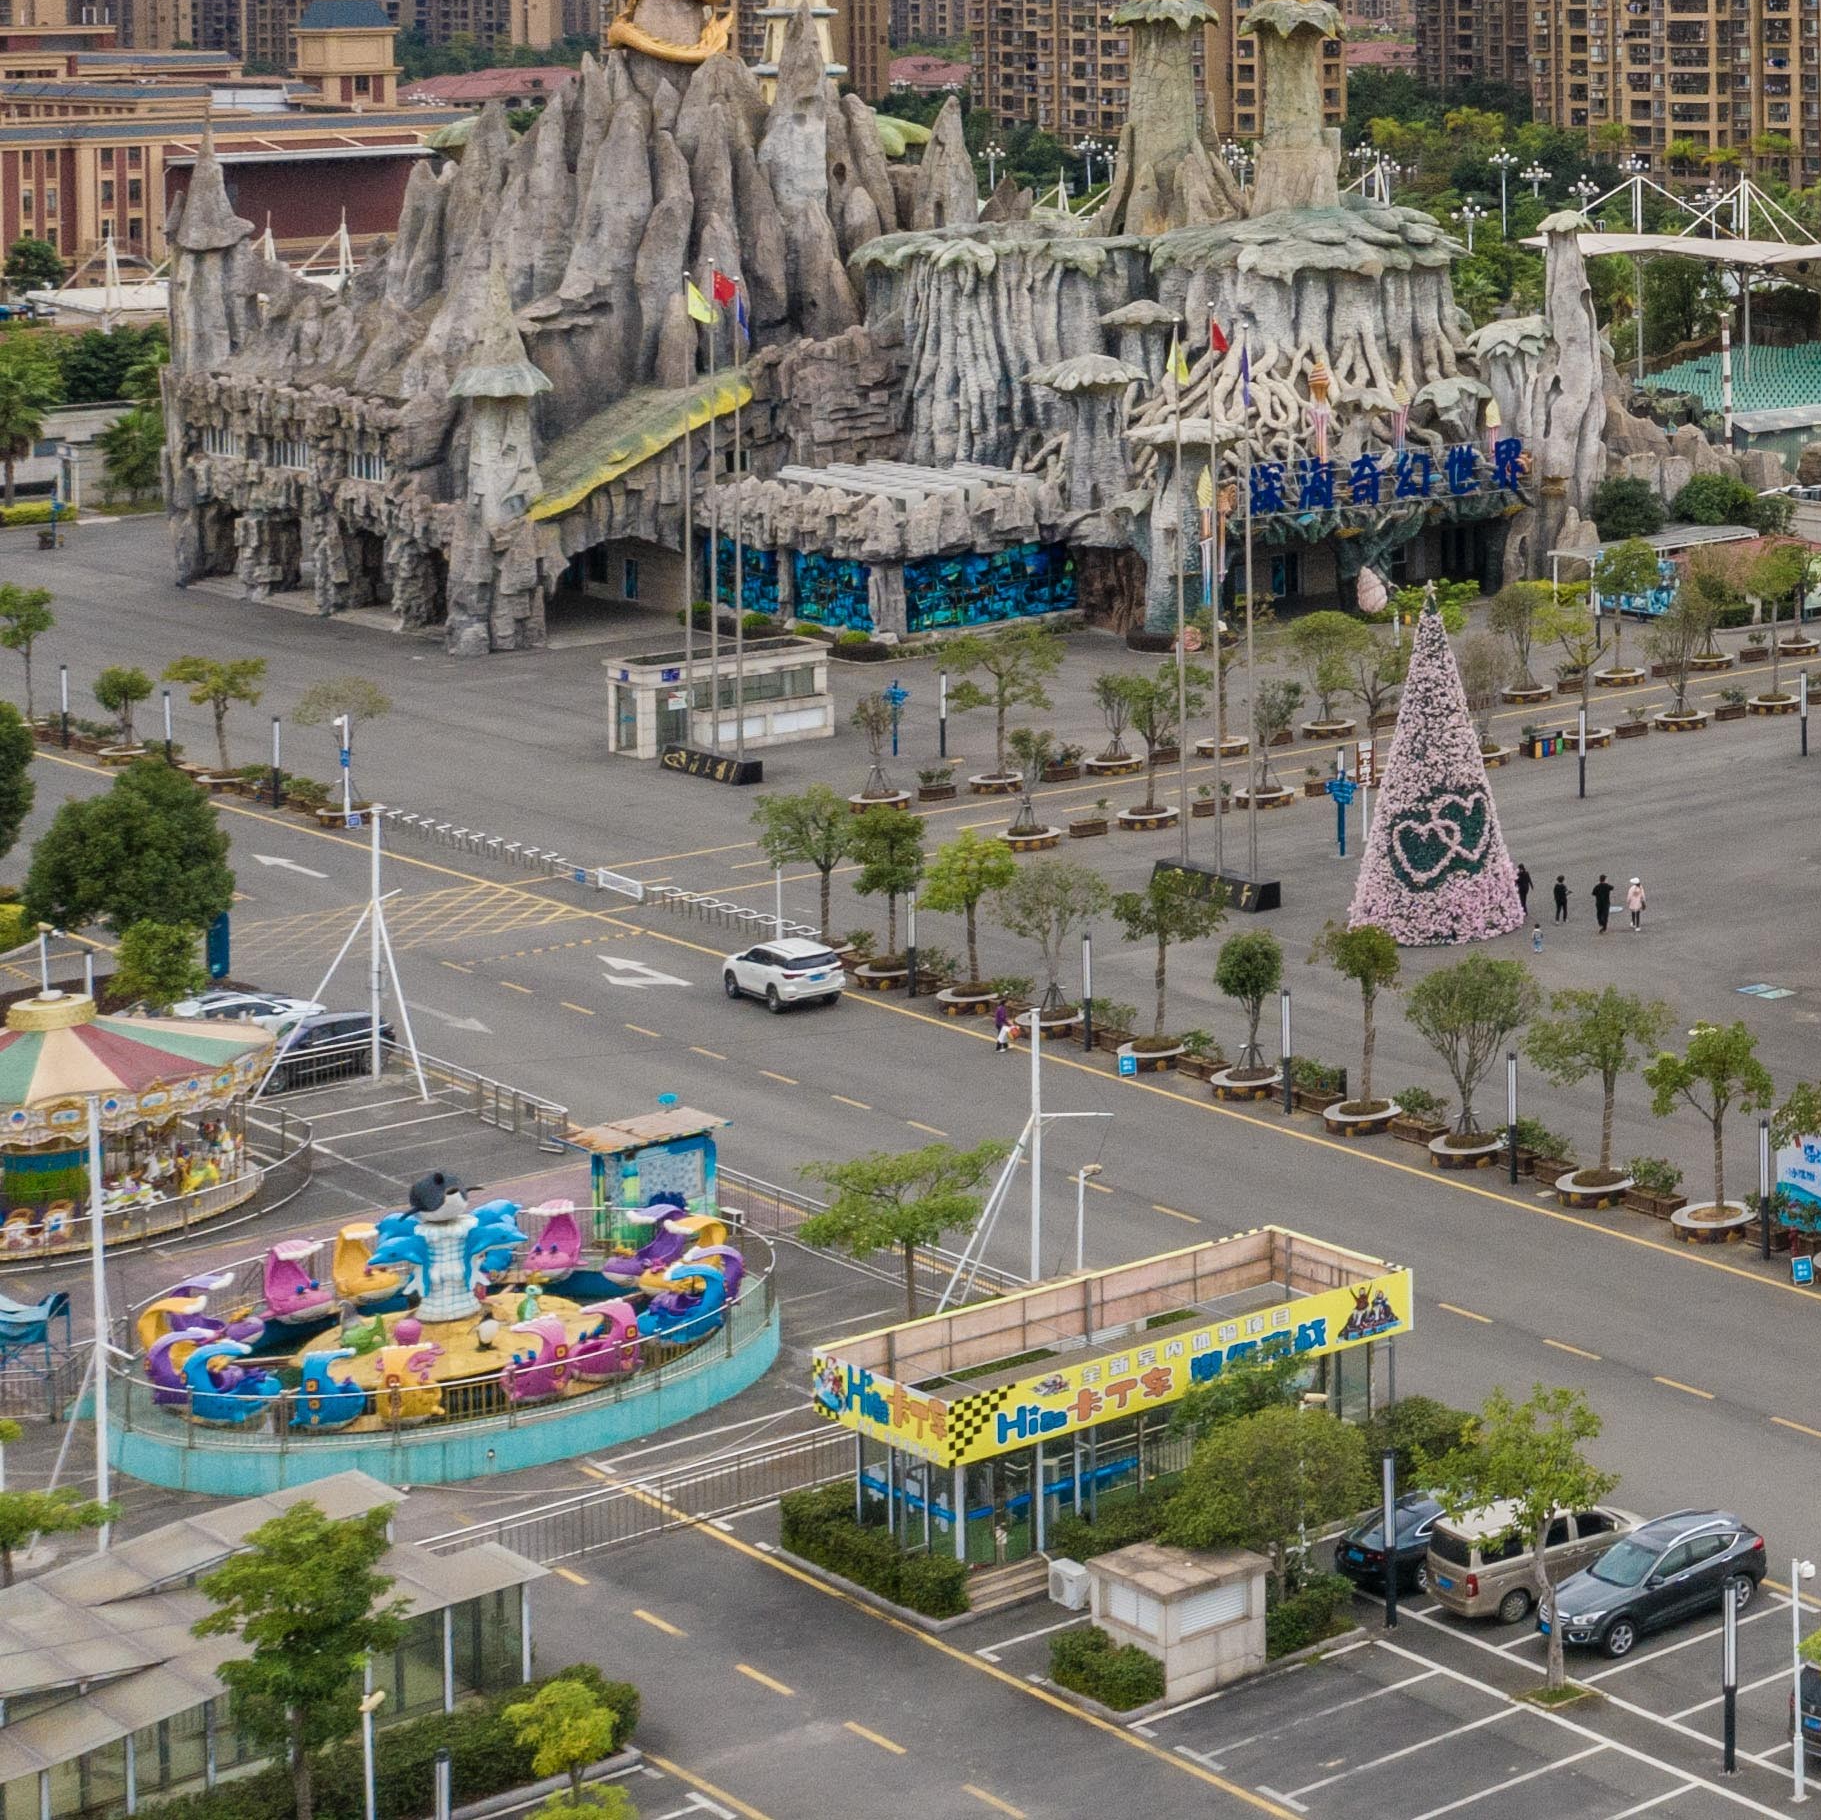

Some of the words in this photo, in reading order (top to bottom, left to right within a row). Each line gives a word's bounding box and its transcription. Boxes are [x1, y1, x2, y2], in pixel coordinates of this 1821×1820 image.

[1249, 436, 1524, 516] 深海奇幻世界
